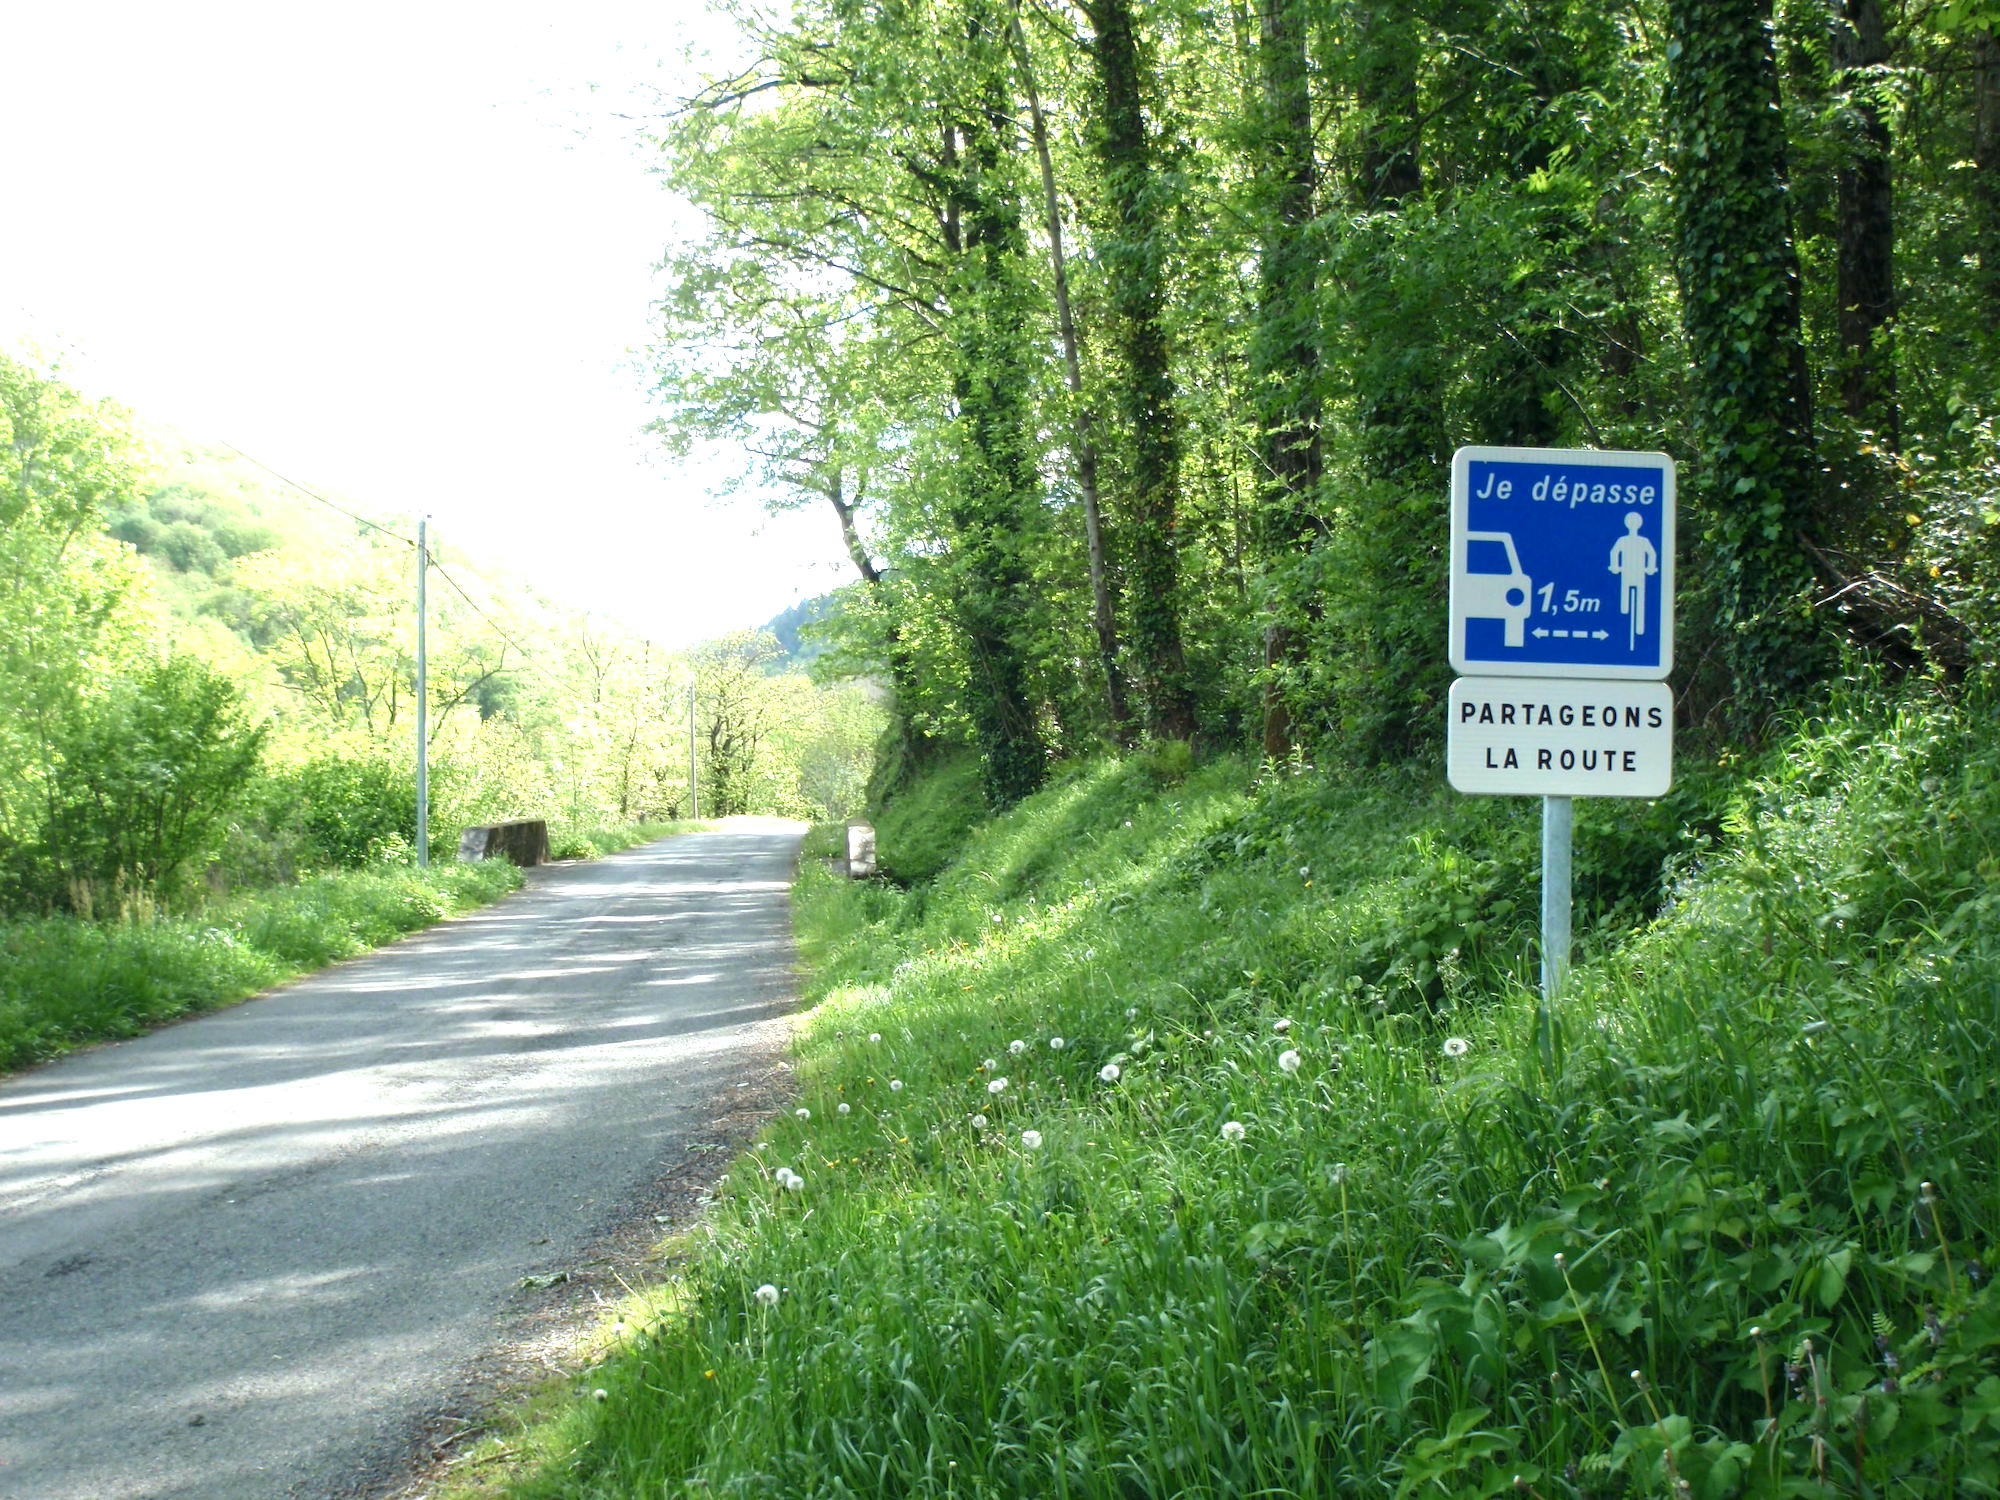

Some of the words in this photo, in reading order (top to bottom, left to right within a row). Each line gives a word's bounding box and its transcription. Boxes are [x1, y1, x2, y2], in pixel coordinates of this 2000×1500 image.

[1476, 472, 1513, 500] Je
[1531, 475, 1656, 509] dépasse
[1461, 702, 1663, 728] PARTAGEONS
[1486, 747, 1519, 769] LA
[1538, 749, 1637, 772] ROUTE
